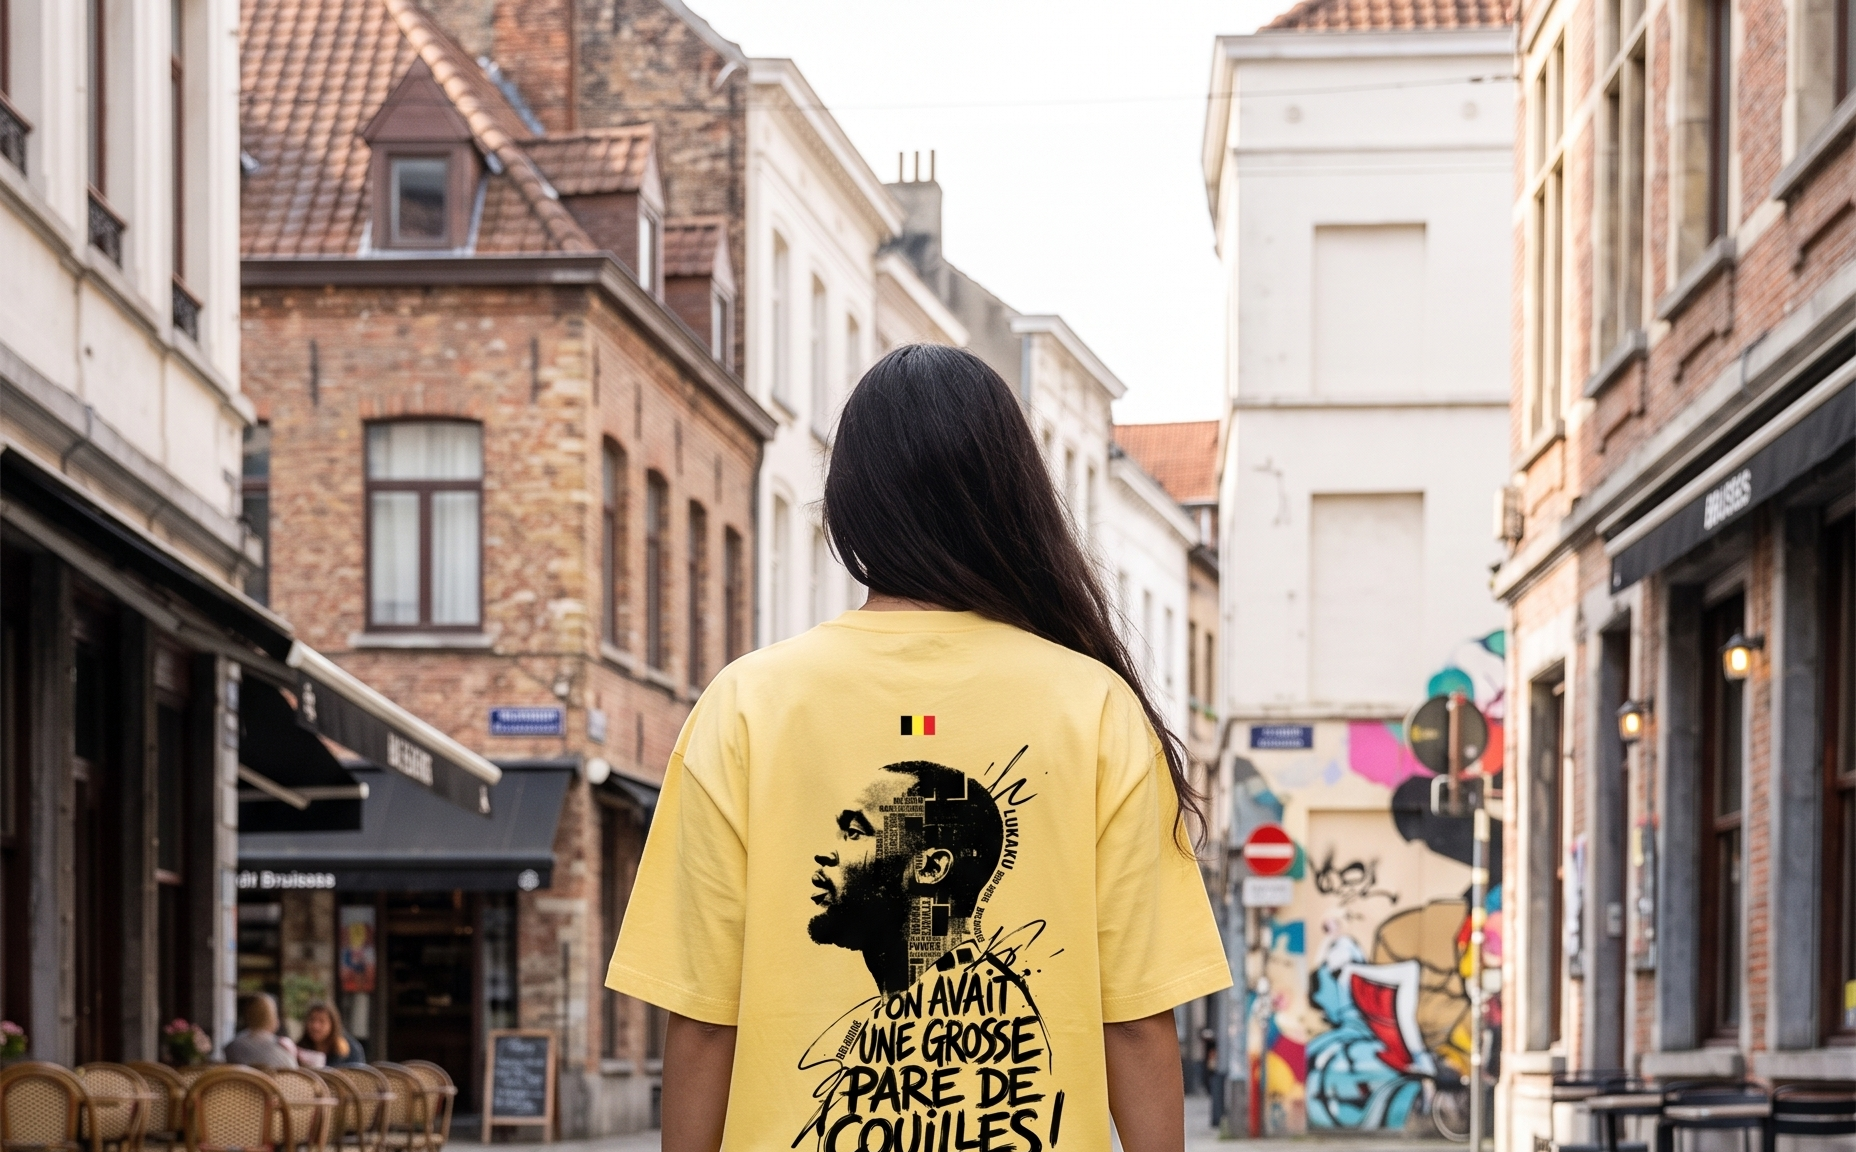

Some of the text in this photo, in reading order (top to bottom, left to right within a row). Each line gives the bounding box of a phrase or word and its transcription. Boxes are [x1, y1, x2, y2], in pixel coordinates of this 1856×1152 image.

[1001, 809, 1019, 870] LUKAKU
[885, 982, 924, 1020] ON
[859, 1021, 917, 1065] UNE
[921, 1016, 1045, 1068] GROSSE
[840, 1064, 1047, 1115] PARE DE
